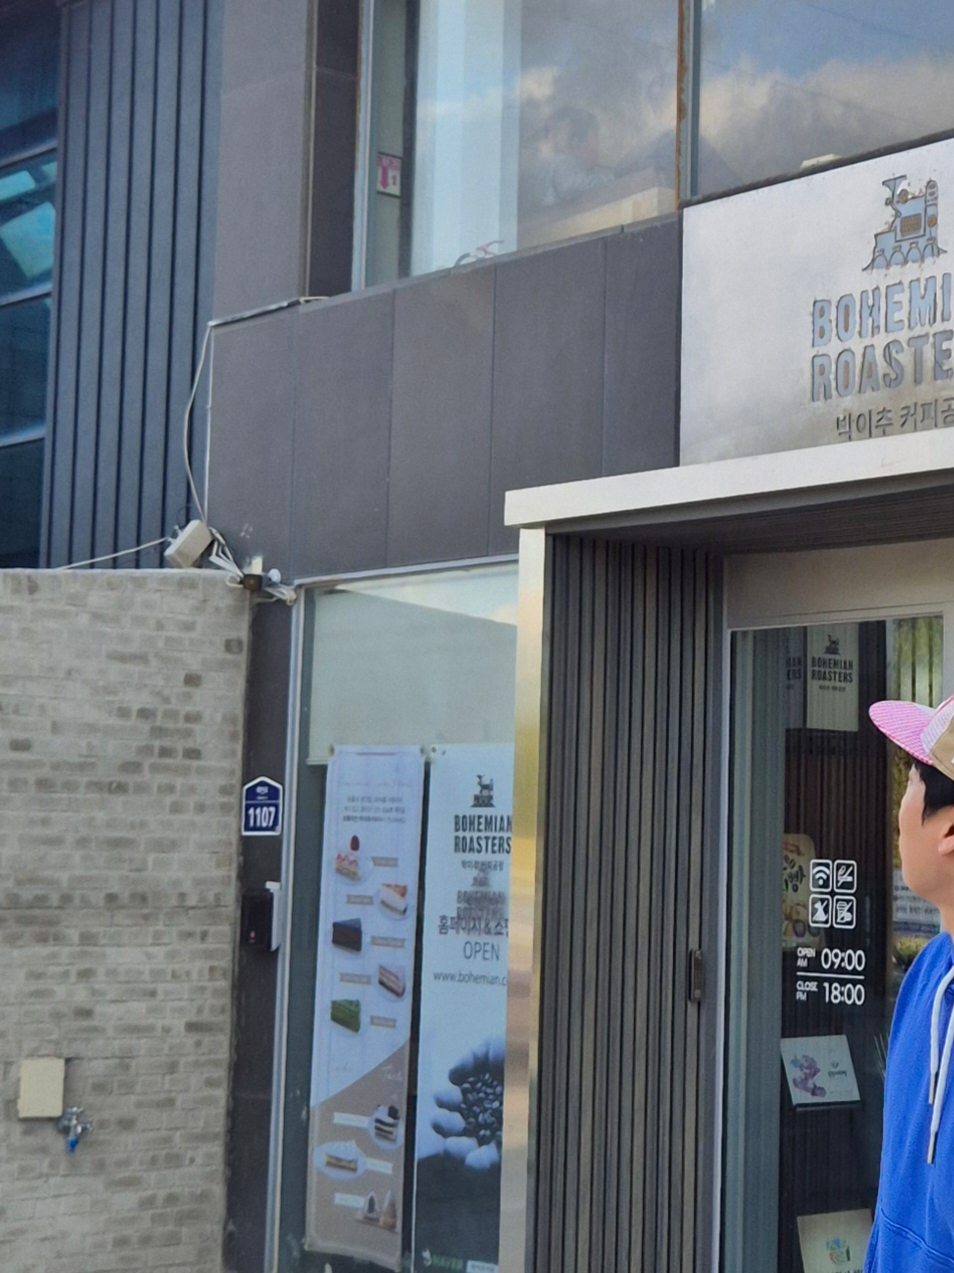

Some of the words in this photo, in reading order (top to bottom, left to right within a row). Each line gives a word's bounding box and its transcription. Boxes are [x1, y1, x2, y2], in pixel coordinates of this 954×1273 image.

[836, 406, 894, 442] 박이추
[811, 656, 854, 671] BOHEMIAN
[811, 669, 854, 683] ROASTERS
[248, 806, 276, 828] 1107
[454, 835, 512, 854] ROASTERS
[463, 940, 500, 962] OPEN
[797, 947, 816, 958] OPEN
[821, 947, 866, 971] 09:00
[797, 957, 808, 967] AM
[796, 980, 819, 992] CLOSE
[823, 982, 865, 1006] 18:00
[796, 991, 807, 1001] PM
